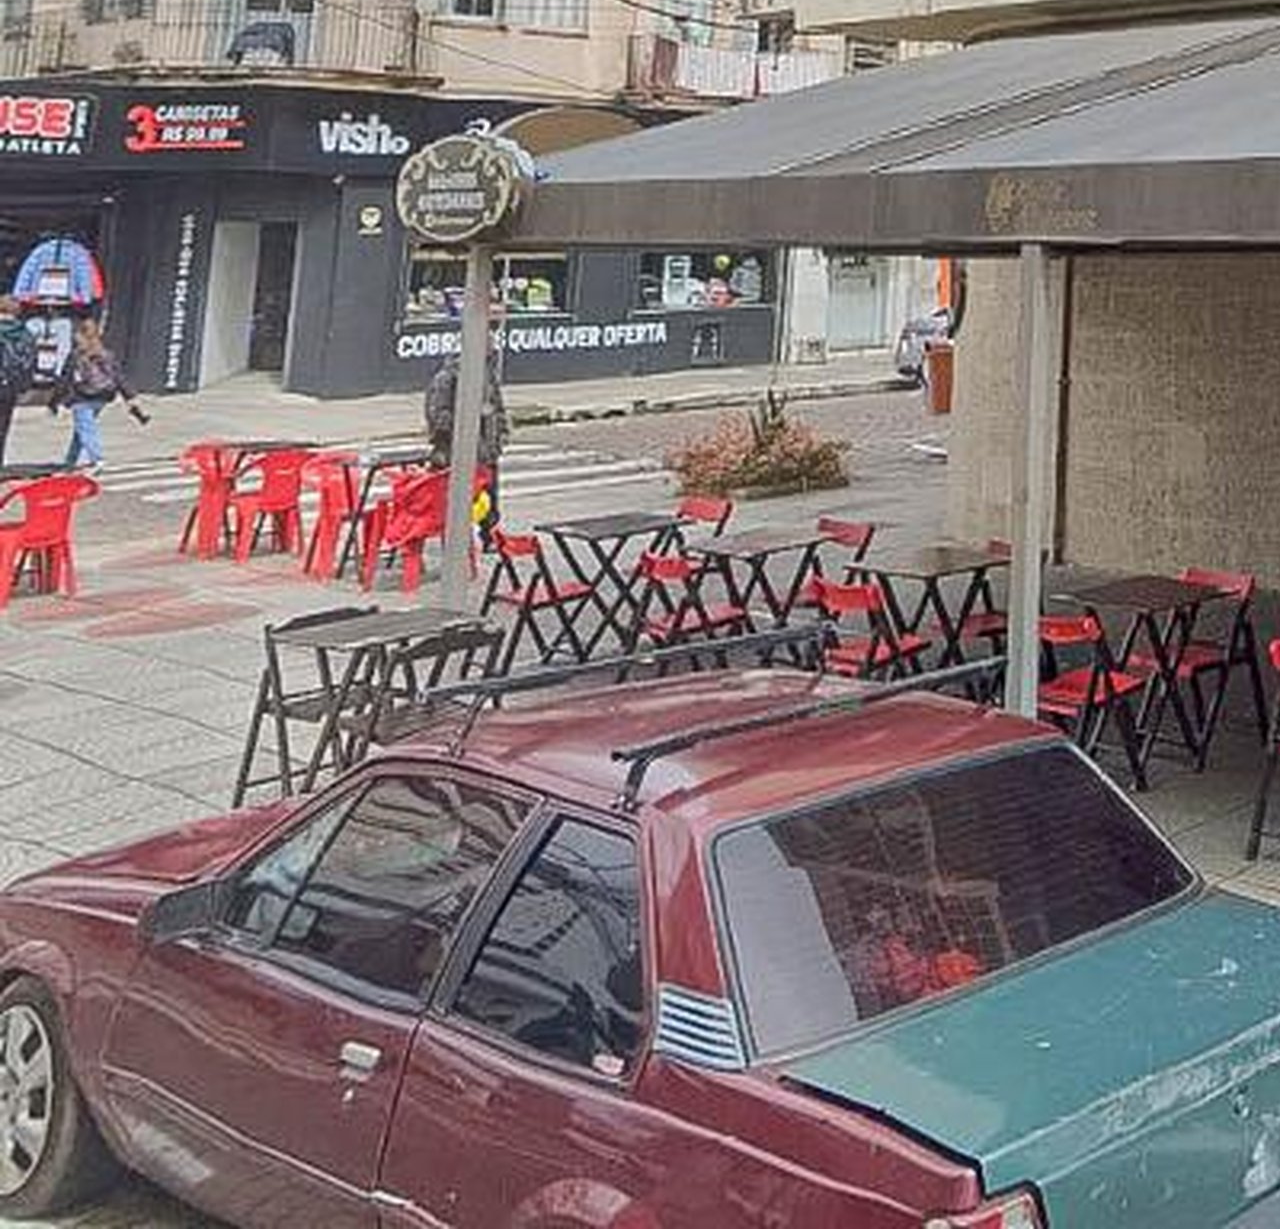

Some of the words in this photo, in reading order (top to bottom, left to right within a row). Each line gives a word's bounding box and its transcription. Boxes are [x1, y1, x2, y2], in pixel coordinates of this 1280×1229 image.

[125, 105, 157, 152] 3
[508, 327, 600, 353] QUALQUER
[603, 323, 667, 348] OFERTA
